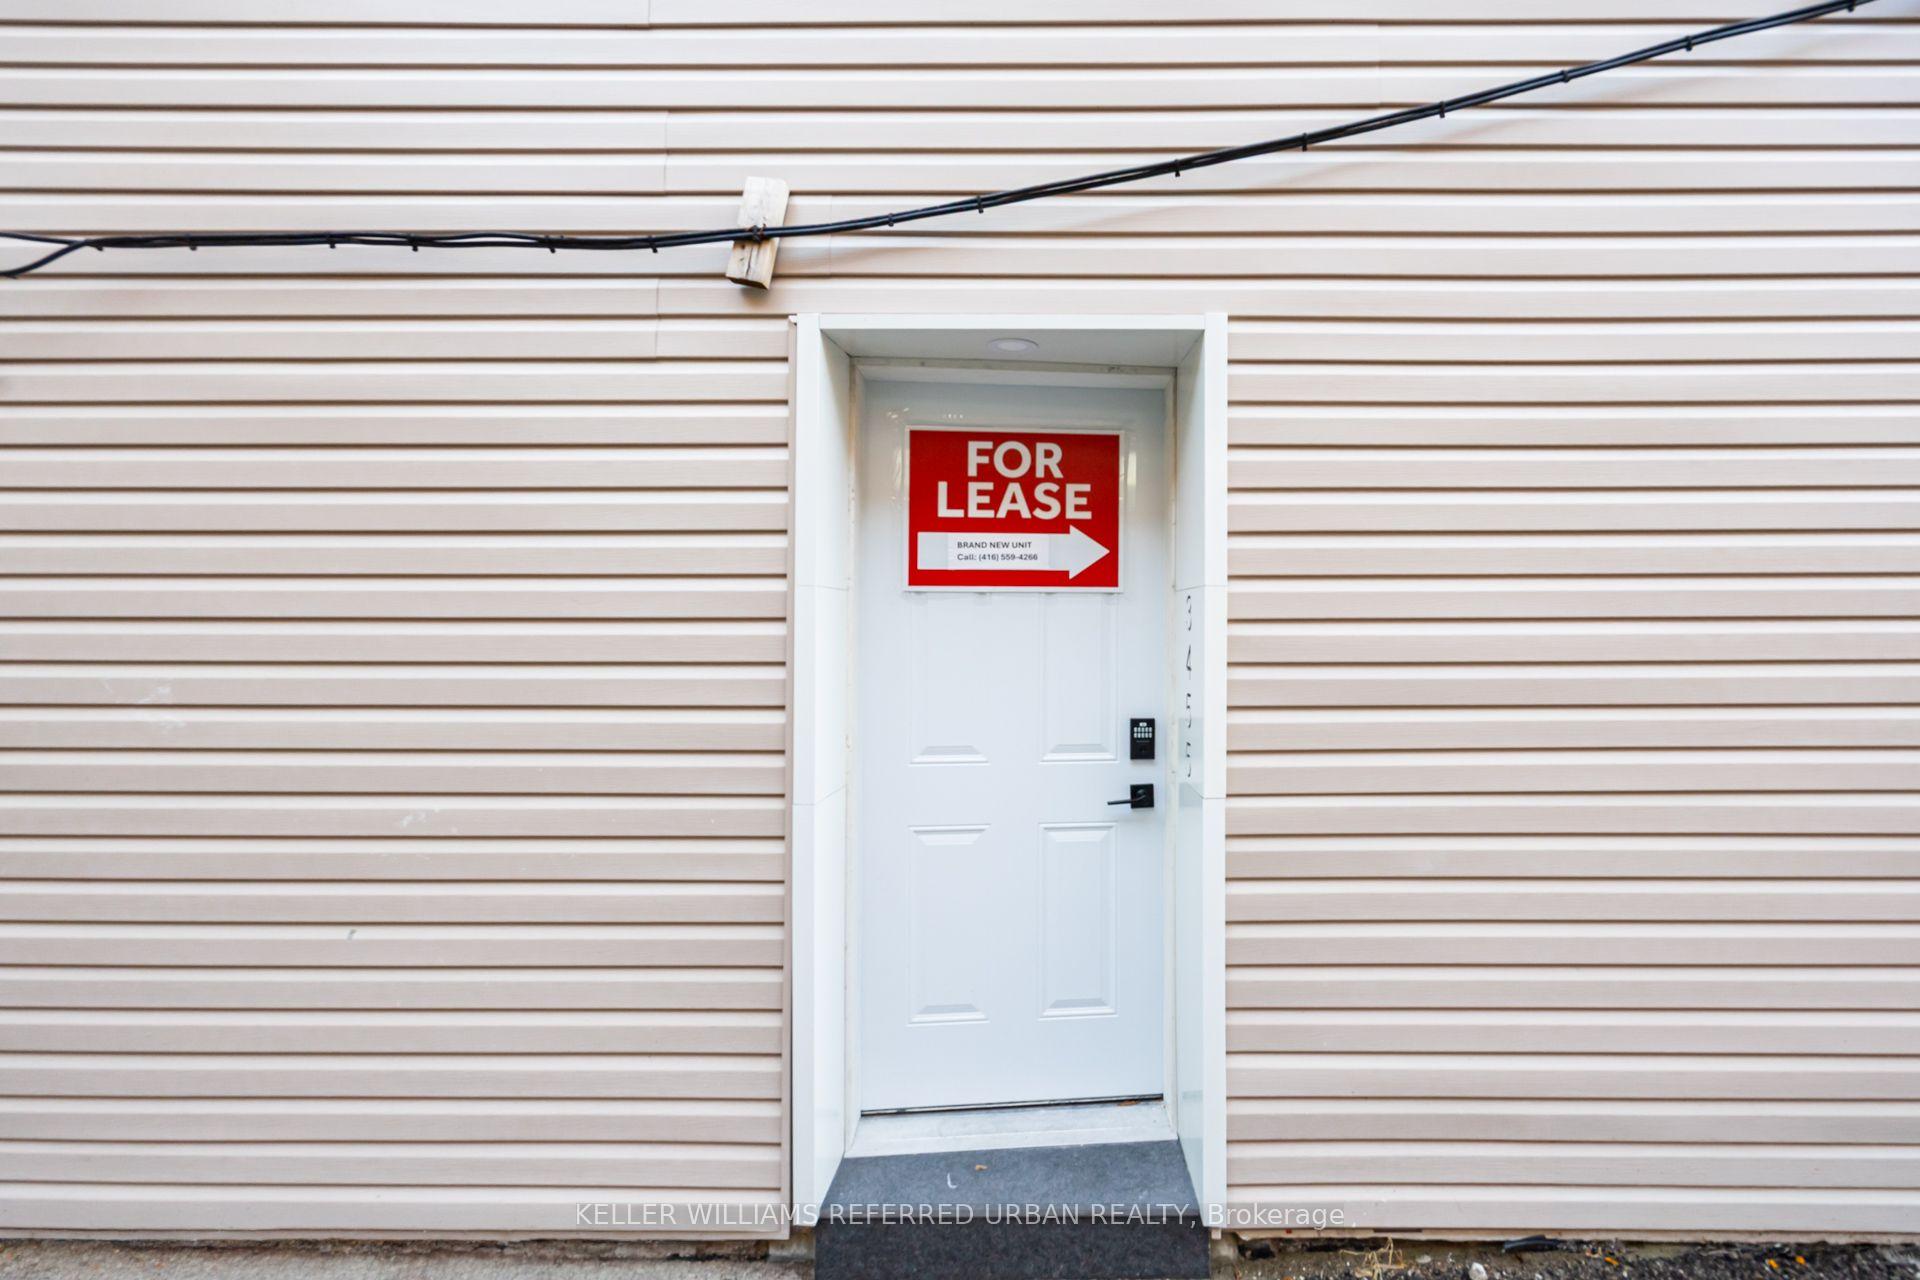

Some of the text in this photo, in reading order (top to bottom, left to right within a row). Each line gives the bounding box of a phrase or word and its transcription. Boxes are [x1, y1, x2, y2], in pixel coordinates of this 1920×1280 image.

[967, 440, 1064, 479] FOR
[937, 481, 1093, 520] LEASE
[957, 541, 1033, 549] BRAND NEW UNIT
[957, 553, 1039, 562] Call: (416) 559-4266
